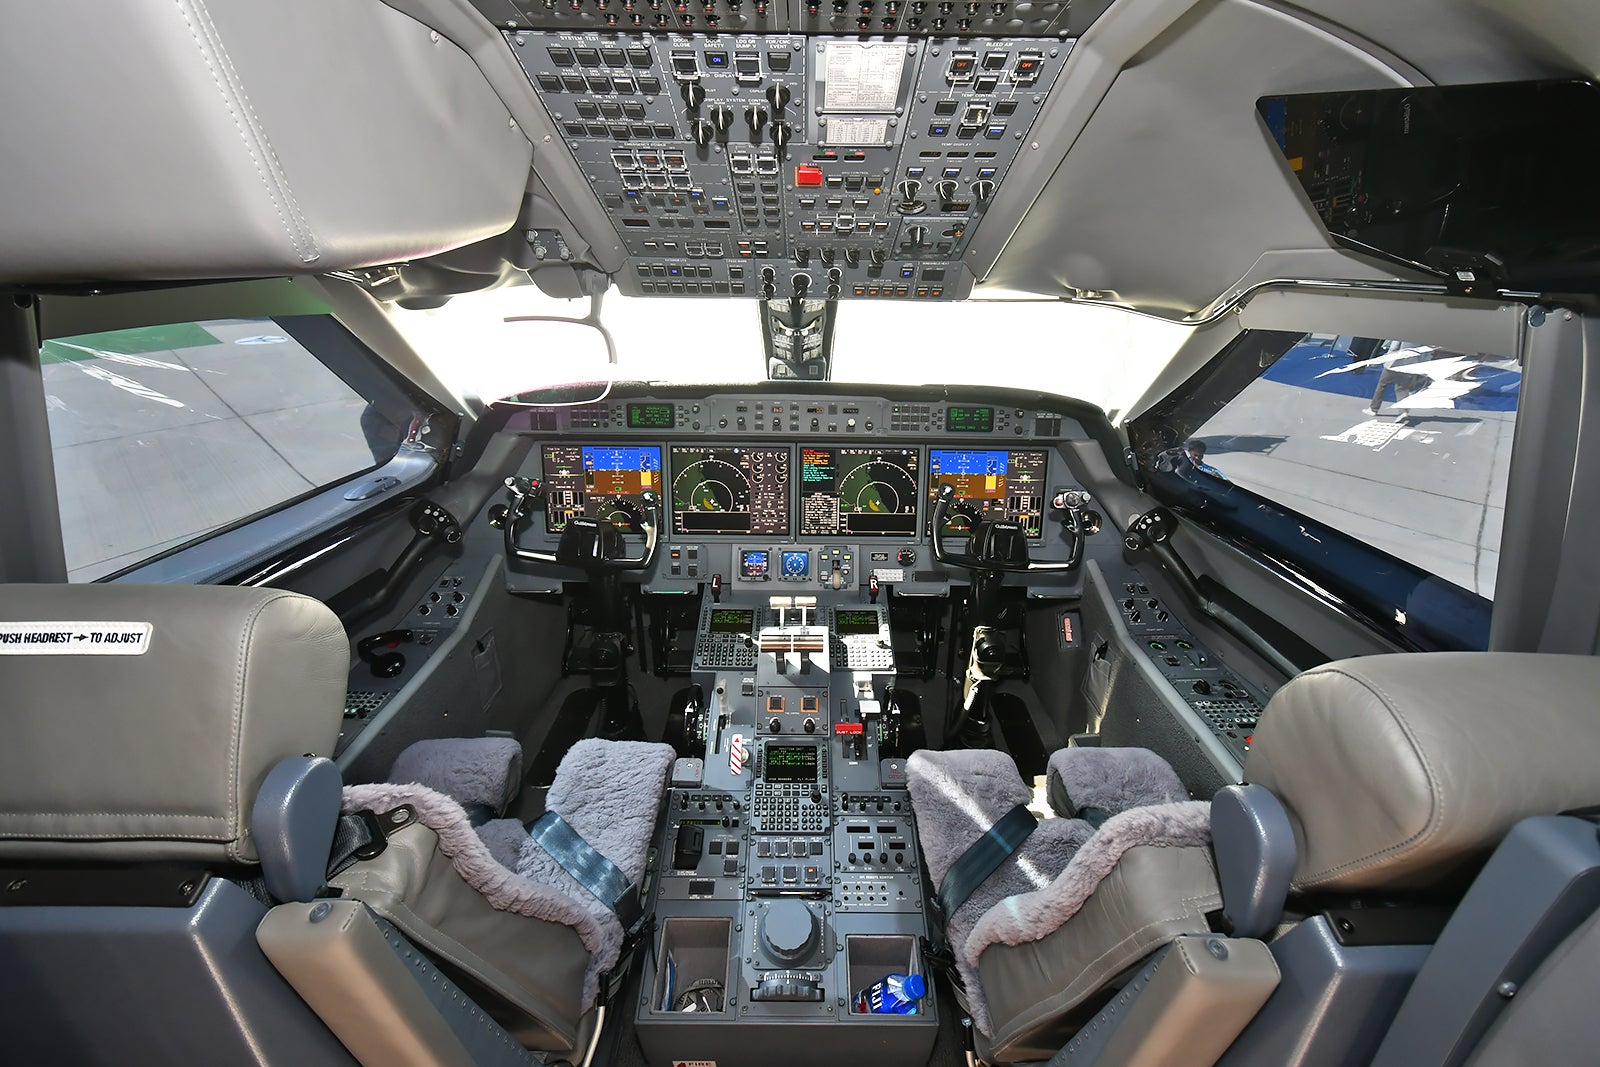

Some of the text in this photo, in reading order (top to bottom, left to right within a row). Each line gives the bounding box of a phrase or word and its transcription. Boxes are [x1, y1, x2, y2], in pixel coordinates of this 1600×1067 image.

[712, 577, 718, 588] L
[870, 579, 878, 589] R
[0, 632, 144, 644] PUSH HEADREST TO ADJUST
[871, 982, 882, 1010] FIJI
